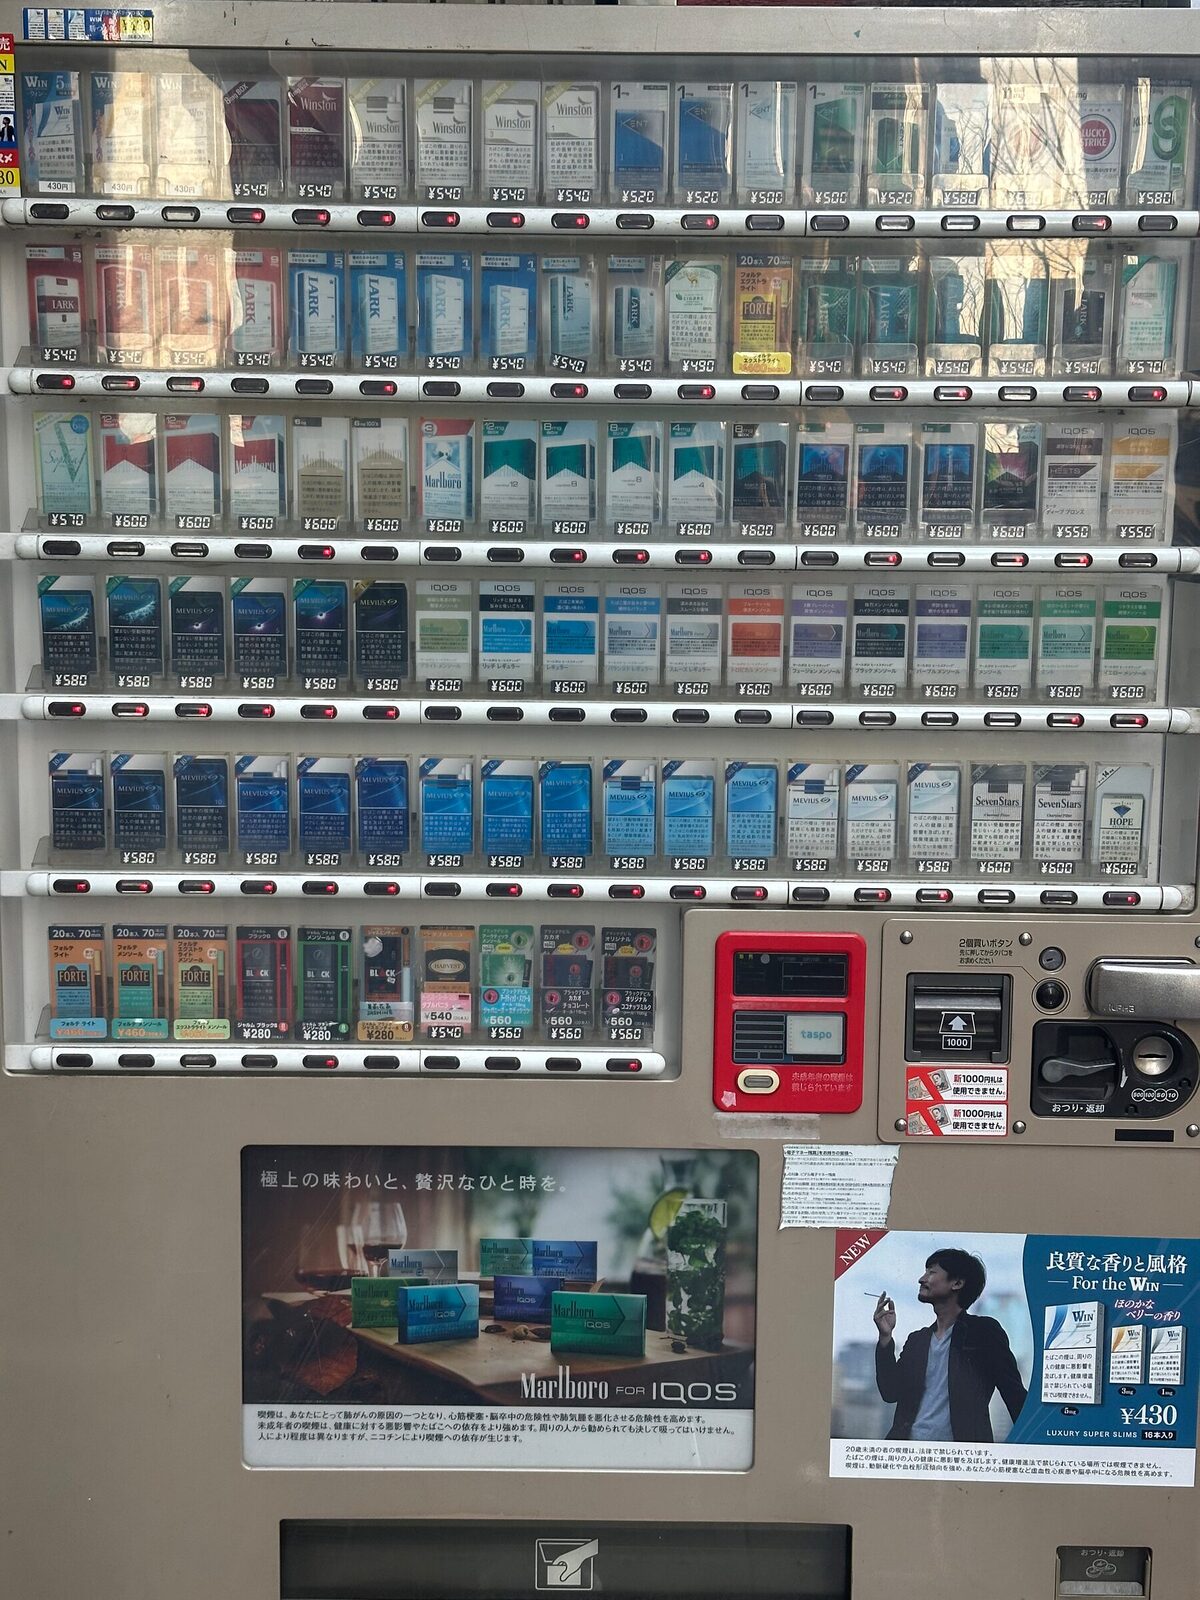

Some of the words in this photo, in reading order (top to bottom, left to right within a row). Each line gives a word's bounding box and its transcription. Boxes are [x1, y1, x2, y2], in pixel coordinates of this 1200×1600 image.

[302, 98, 337, 112] Winston
[556, 102, 592, 116] Winston
[366, 120, 400, 134] Winston
[433, 120, 467, 134] Winston
[496, 114, 530, 129] Winston
[1082, 128, 1106, 138] LUCKY
[47, 182, 68, 191] 430円
[234, 184, 267, 197] ¥540
[429, 187, 460, 200] ¥540
[623, 191, 654, 202] ¥520
[816, 192, 846, 204] ¥500
[1138, 192, 1170, 204] ¥580
[308, 276, 320, 318] LARK
[369, 278, 380, 320] LARK
[435, 278, 446, 320] LARK
[52, 300, 74, 310] LARK
[244, 283, 256, 324] LARK
[499, 288, 511, 328] LARK
[744, 302, 772, 315] FORTE
[631, 296, 639, 327] LARK
[174, 352, 205, 364] ¥540
[366, 356, 397, 368] ¥540
[553, 355, 584, 372] ¥540
[810, 361, 841, 372] ¥540
[1001, 362, 1032, 373] ¥540
[425, 471, 462, 490] Marlboro
[52, 514, 83, 526] ¥570
[242, 518, 273, 529] ¥600
[429, 520, 460, 532] ¥600
[617, 523, 648, 534] ¥600
[805, 524, 836, 536] ¥600
[930, 526, 961, 537] ¥600
[1120, 526, 1152, 538] ¥550
[430, 584, 457, 592] IQOS
[494, 584, 520, 592] IQOS
[558, 586, 584, 594] IQOS
[620, 587, 646, 595] IQOS
[681, 587, 708, 595] IQOS
[744, 588, 770, 596] IQOS
[930, 589, 957, 597] IQOS
[994, 590, 1020, 598] IQOS
[1056, 590, 1082, 598] IQOS
[1120, 591, 1147, 599] IQOS
[181, 677, 212, 688] ¥580
[368, 679, 398, 690] ¥580
[555, 682, 585, 693] ¥600
[740, 684, 770, 695] ¥600
[925, 686, 956, 697] ¥600
[1112, 687, 1143, 698] ¥600
[1109, 818, 1133, 826] HOPE
[246, 854, 277, 865] ¥580
[430, 856, 460, 866] ¥580
[614, 858, 644, 869] ¥580
[796, 860, 826, 871] ¥580
[980, 862, 1011, 873] ¥600
[960, 938, 1013, 947] 2個買いボタン
[60, 972, 86, 982] FORTE
[122, 972, 148, 982] FORTE
[183, 972, 208, 982] FORTE
[424, 1012, 452, 1020] ¥540
[484, 1016, 511, 1025] ¥560
[545, 1016, 572, 1025] ¥560
[605, 1017, 632, 1026] ¥560
[243, 1028, 271, 1039] ¥280
[304, 1030, 331, 1040] ¥280
[367, 1030, 393, 1040] ¥280
[432, 1026, 462, 1038] ¥540
[611, 1029, 641, 1040] ¥560
[801, 1030, 832, 1040] taspo
[947, 1038, 968, 1047] 1000
[953, 1074, 1002, 1083] 新1000円札は
[792, 1083, 853, 1092] 禁じられています
[953, 1109, 1002, 1118] 新1000円札は
[1052, 1104, 1105, 1113] おつり・返却
[260, 1170, 566, 1193] 極上の味わいと、贅沢なひと時を。
[534, 1245, 563, 1257] Marlboro
[839, 1234, 872, 1266] NEW
[391, 1256, 422, 1268] Marlboro
[1046, 1252, 1188, 1274] 良質な香りと風格
[1072, 1276, 1098, 1290] For
[1102, 1276, 1126, 1290] the
[409, 1295, 444, 1310] Marlboro
[1114, 1299, 1155, 1309] ほのかな
[553, 1301, 594, 1318] Marlboro
[1126, 1310, 1181, 1320] ベリーの香り
[1086, 1334, 1092, 1344] 5
[521, 1365, 609, 1400] Marlboro
[616, 1386, 645, 1395] FOR
[653, 1382, 737, 1404] IQOS
[1121, 1404, 1177, 1425] ¥430
[258, 1432, 523, 1443] 人により程度は異なりますが、ニコチンにより喫煙への依存が生じます。
[846, 1446, 992, 1456] 20歳未満の者の喫煙は、法律で禁じられています。
[1081, 1549, 1125, 1557] おつり・返却
